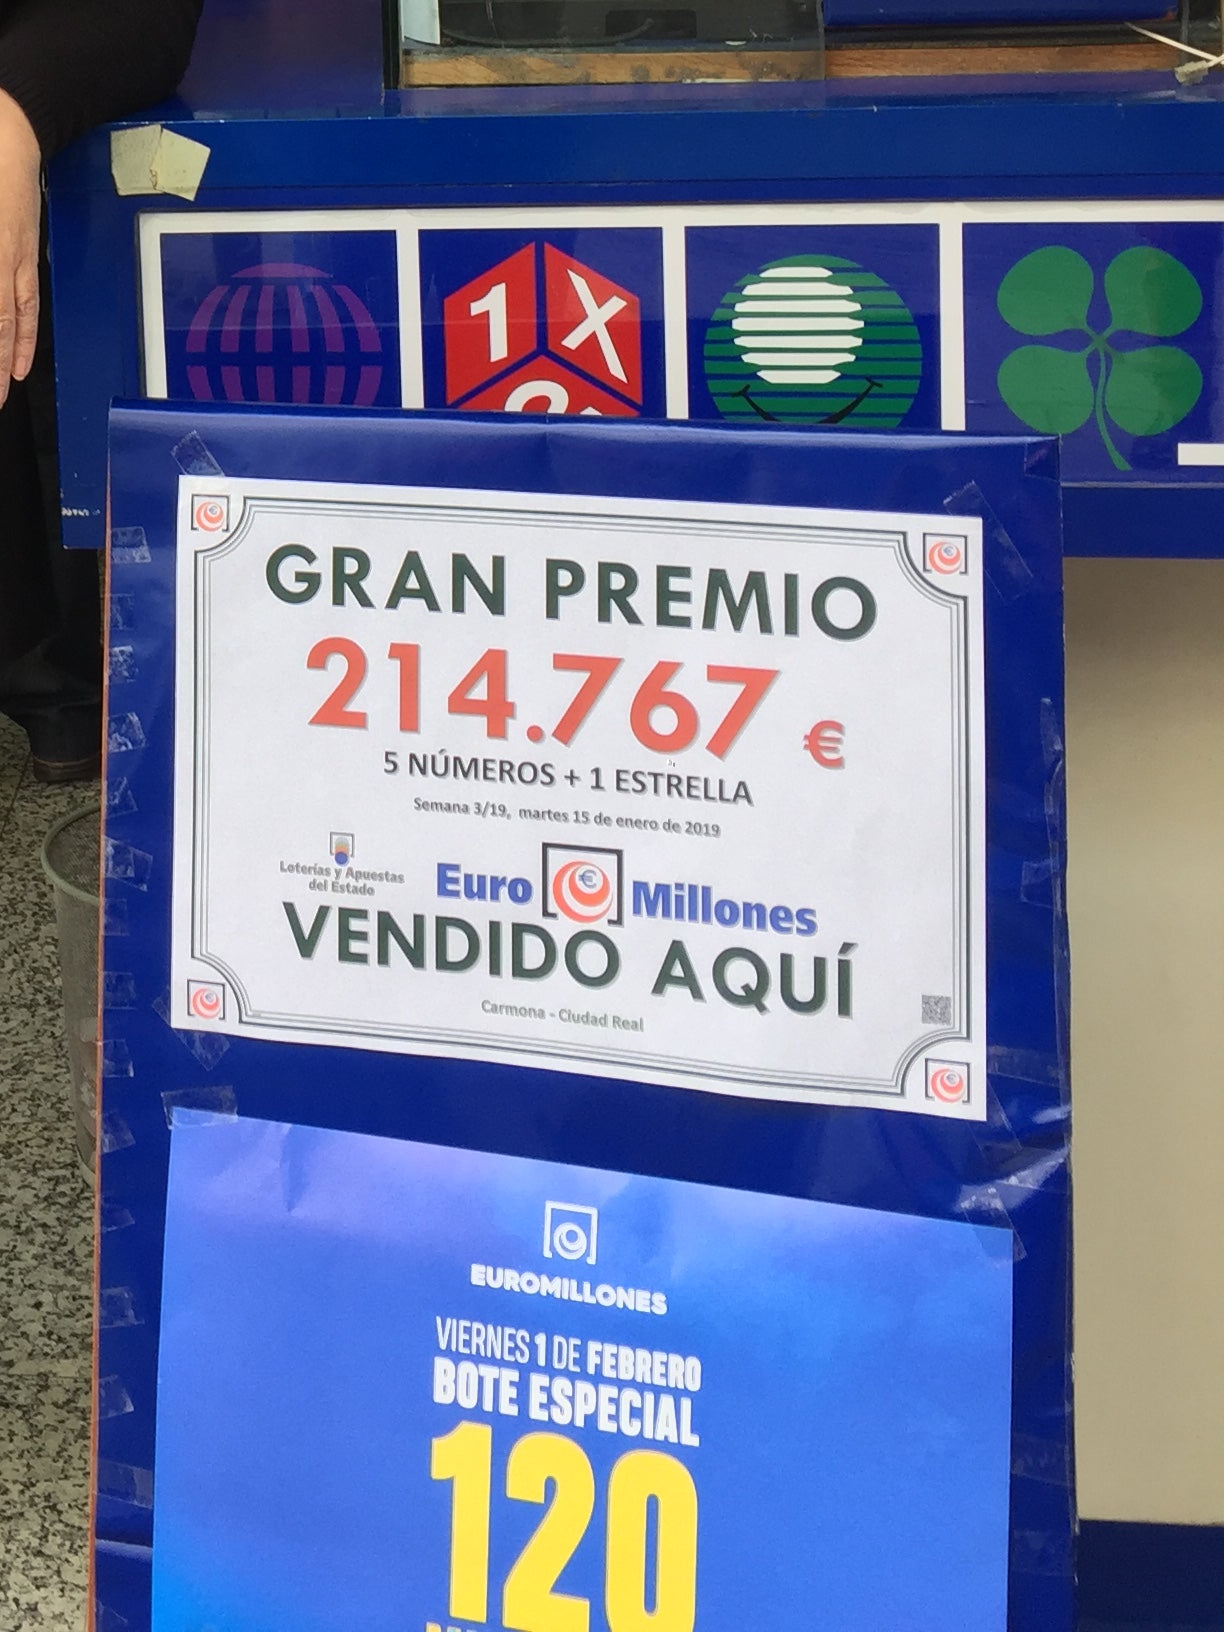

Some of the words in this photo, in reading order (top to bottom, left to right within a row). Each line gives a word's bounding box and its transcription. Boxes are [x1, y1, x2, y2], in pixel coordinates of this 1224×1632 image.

[266, 544, 504, 616] GRAN
[546, 558, 876, 640] PREMIO
[307, 637, 780, 761] 214.767
[803, 720, 845, 769] €
[384, 751, 398, 773] 5
[407, 745, 555, 786] NÚMEROS
[591, 768, 604, 790] 1
[616, 769, 752, 804] ESTRELLA
[414, 798, 469, 814] Semana
[474, 802, 511, 819] 3/19,
[519, 809, 569, 822] martes
[574, 811, 590, 824] 15
[594, 812, 612, 826] de
[616, 817, 658, 830] enero
[663, 819, 681, 833] de
[685, 821, 720, 837] 2019
[280, 861, 331, 877] Loterías
[335, 868, 342, 880] y
[346, 867, 404, 883] Apuestas
[309, 879, 328, 891] del
[332, 881, 375, 896] Estado
[437, 863, 532, 904] Euro
[633, 880, 818, 936] Millones
[283, 901, 620, 987] VENDIDO
[652, 940, 859, 1019] AQUÍ
[482, 1000, 545, 1019] Carmona
[559, 1009, 608, 1027] Ciudad
[613, 1016, 643, 1032] Real
[471, 1264, 667, 1314] EUROMILLONES
[435, 1317, 529, 1364] VIERNES
[535, 1333, 546, 1366] 1
[553, 1335, 581, 1372] DE
[587, 1341, 701, 1392] FEBRERO
[434, 1356, 519, 1416] BOTE
[529, 1373, 700, 1448] ESPECIAL
[429, 1420, 698, 1632] 120
